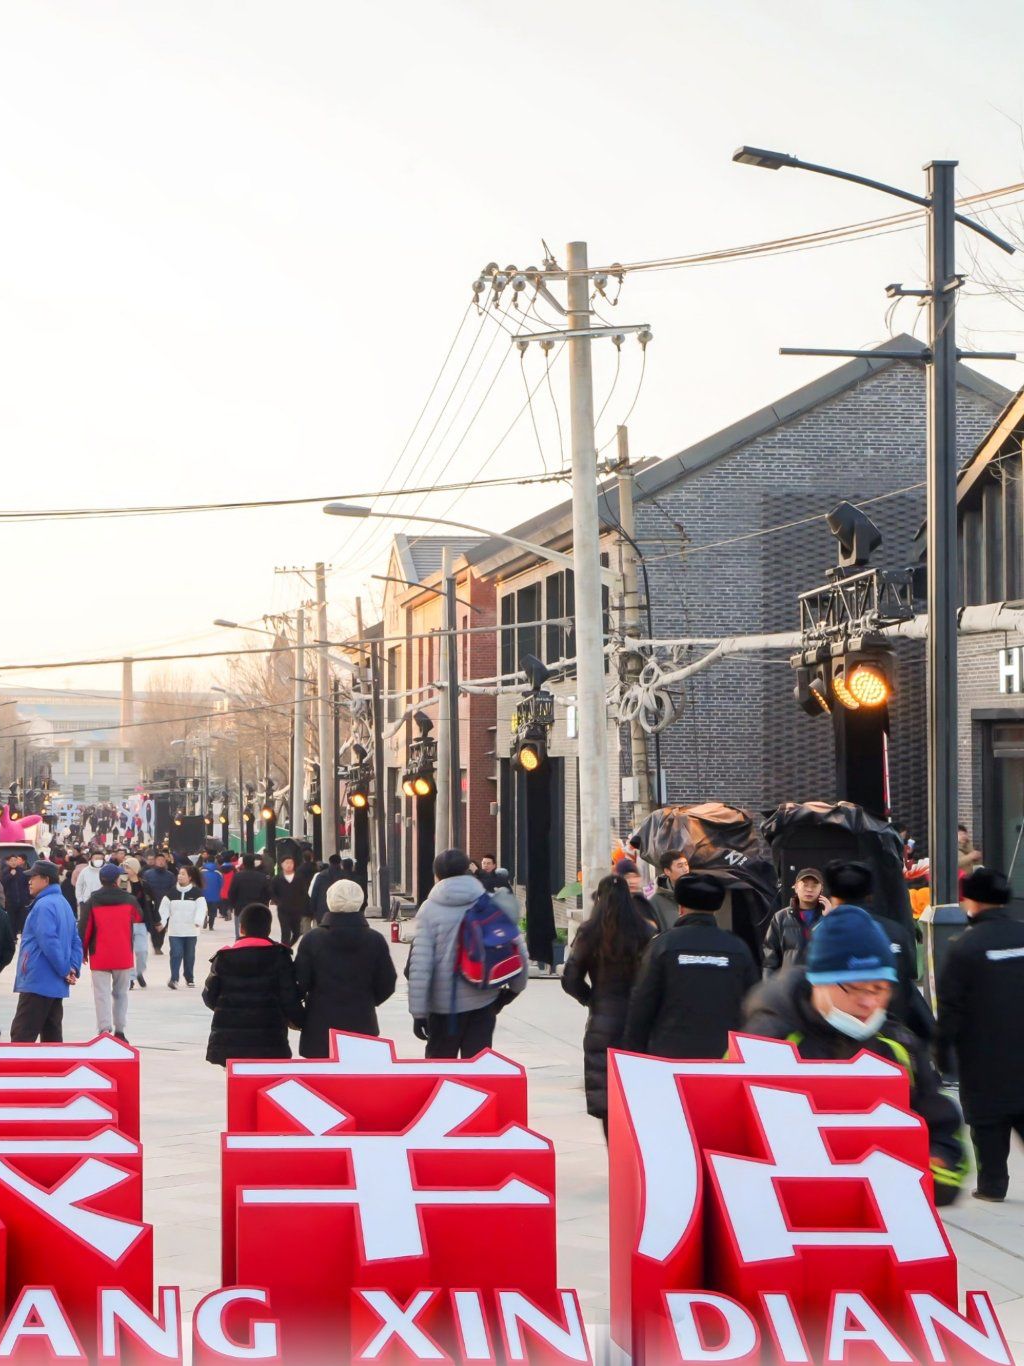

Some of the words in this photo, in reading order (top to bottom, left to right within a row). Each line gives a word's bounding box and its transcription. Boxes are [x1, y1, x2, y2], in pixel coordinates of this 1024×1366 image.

[999, 647, 1024, 693] H
[353, 1286, 592, 1364] XIN
[661, 1289, 1016, 1366] DIAN
